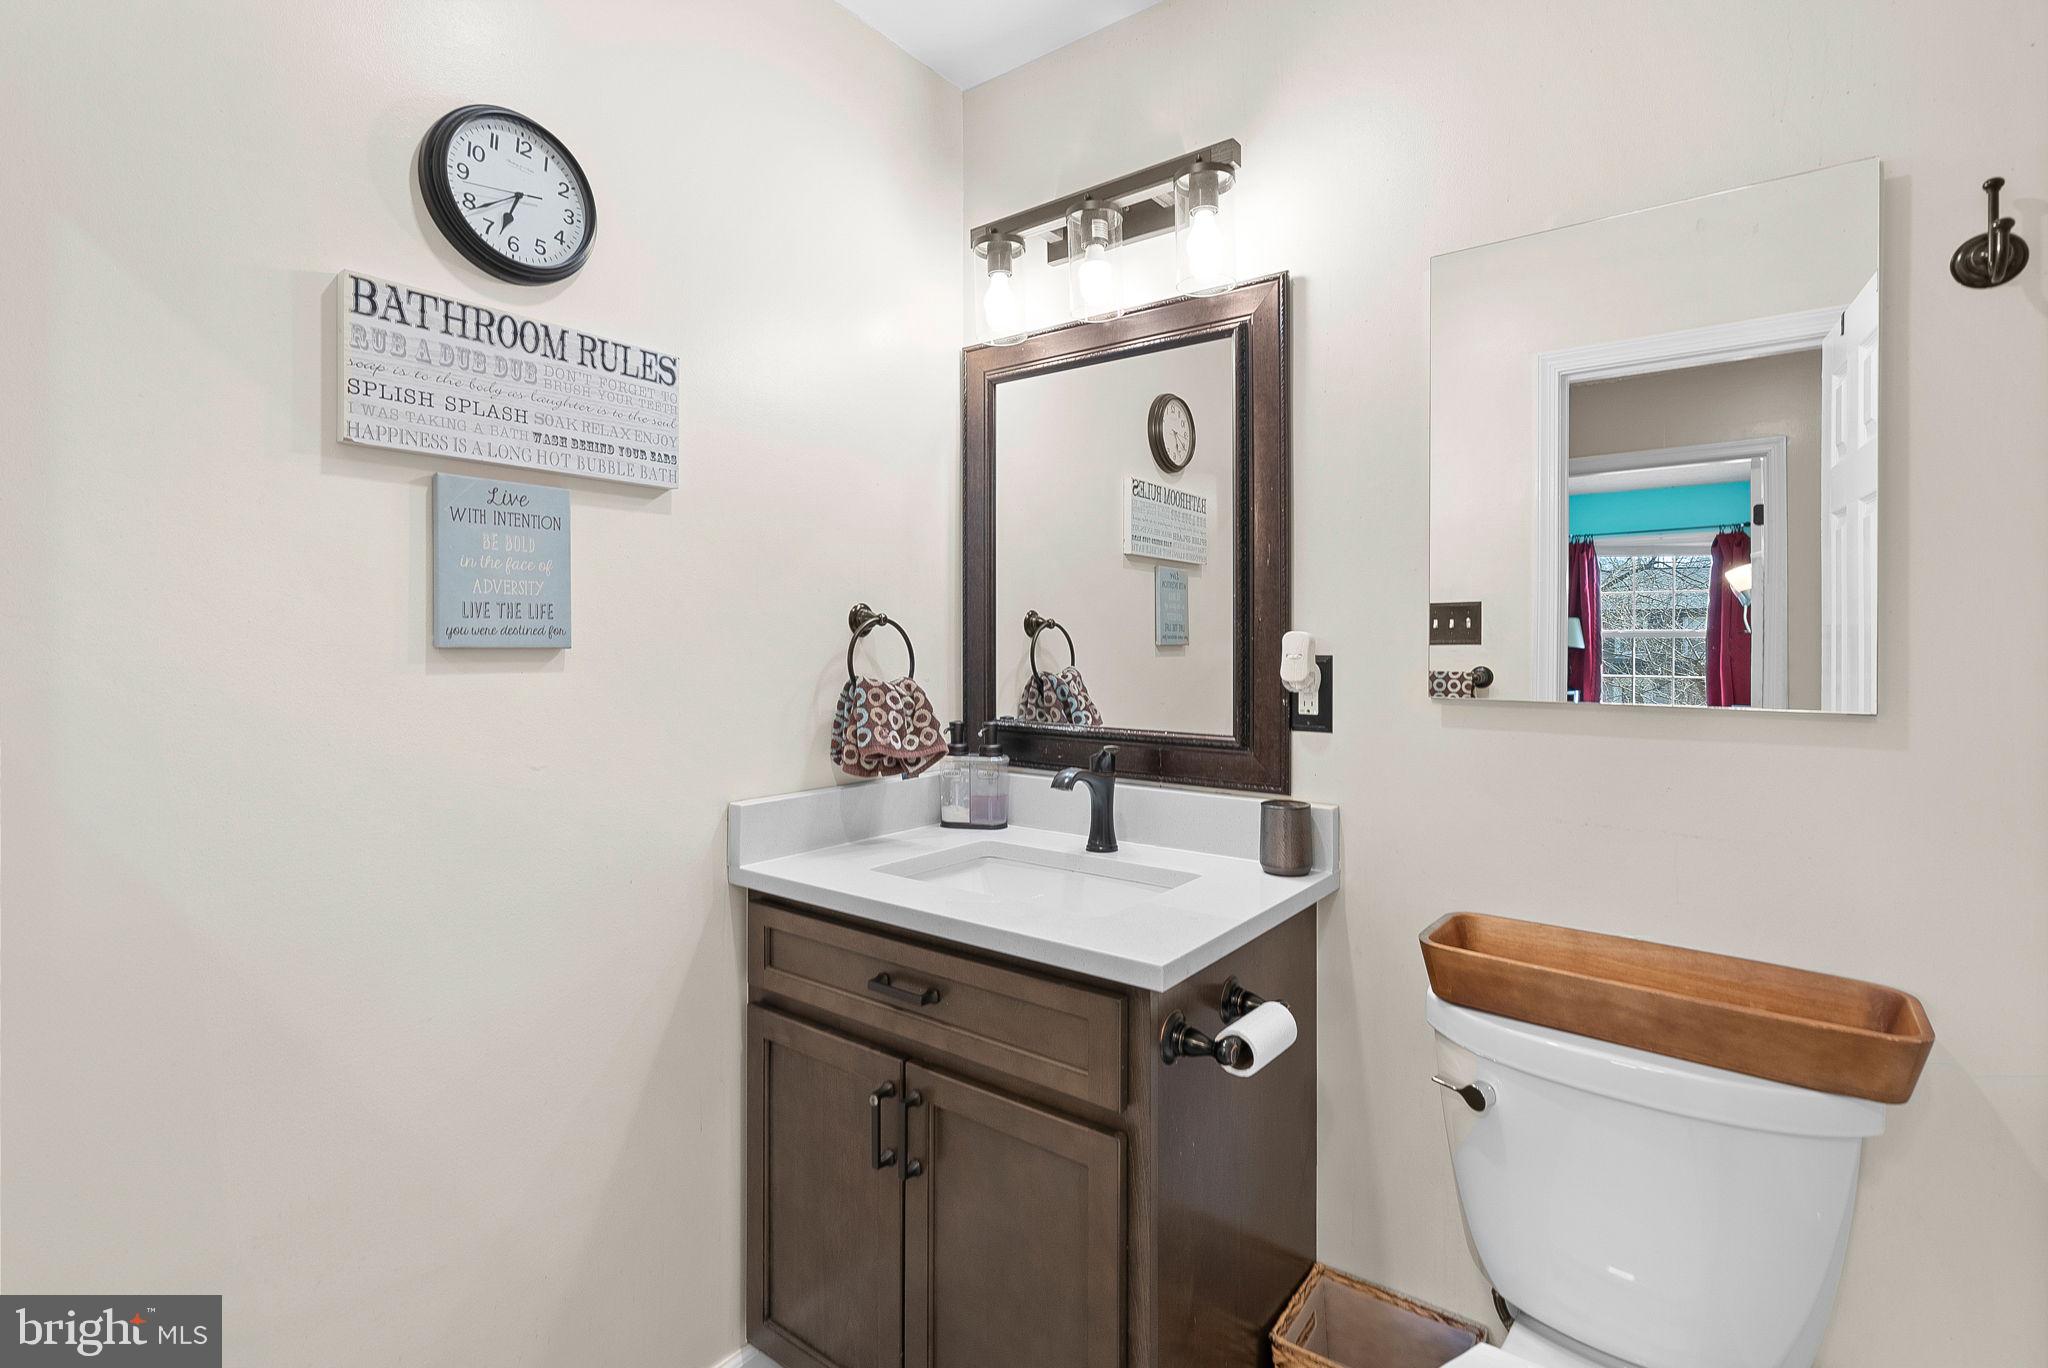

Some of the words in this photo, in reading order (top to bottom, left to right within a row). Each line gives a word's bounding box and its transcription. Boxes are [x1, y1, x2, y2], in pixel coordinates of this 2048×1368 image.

[489, 132, 499, 150] 11
[515, 138, 533, 159] 12
[467, 141, 485, 162] 10
[456, 162, 470, 180] 9
[544, 156, 548, 172] 1
[557, 182, 570, 199] 2
[462, 193, 476, 209] 8
[483, 218, 495, 234] 7
[563, 209, 574, 225] 3
[507, 236, 520, 252] 6
[534, 239, 546, 255] 5
[554, 230, 565, 246] 4
[349, 275, 569, 362] BATHROOM
[577, 332, 680, 386] RULES
[349, 323, 406, 358] RUB
[416, 339, 432, 365] A
[439, 342, 486, 375] DUB
[493, 356, 538, 385] DUB
[347, 358, 386, 376] soap
[392, 365, 407, 376] is
[415, 370, 430, 381] to
[436, 372, 464, 387] the
[469, 379, 502, 399] body
[507, 390, 523, 400] as
[530, 389, 594, 413] laughter
[596, 405, 608, 415] is
[613, 408, 624, 419] to
[628, 410, 648, 424] the
[651, 416, 678, 428] soul
[544, 365, 592, 385] DON'T
[599, 377, 656, 399] FORGET
[661, 390, 678, 404] TO
[544, 380, 591, 397] BRUSH
[598, 389, 633, 406] YOUR
[638, 398, 678, 415] TEETH
[347, 378, 435, 408] SPLISH
[444, 395, 529, 424] SPLASH
[534, 412, 581, 431] SOAK
[581, 421, 631, 441] RELAX
[634, 431, 678, 448] ENJOY
[348, 401, 354, 413] I
[361, 403, 399, 420] WAS
[406, 411, 468, 431] TAKING
[473, 423, 484, 434] A
[490, 425, 529, 441] BATH
[532, 432, 568, 448] WASH
[571, 438, 615, 455] BEHIND
[618, 446, 647, 461] YOUR
[650, 452, 678, 465] EARS
[346, 420, 449, 450] HAPPINESS
[453, 438, 467, 453] IS
[472, 440, 483, 456] A
[487, 442, 533, 463] LONG
[537, 451, 572, 469] HOT
[576, 455, 635, 478] BUBBLE
[640, 464, 678, 484] BATH
[486, 487, 530, 507] Live
[450, 506, 486, 524] WITH
[493, 510, 561, 531] INTENTION
[482, 533, 498, 550] BE
[505, 535, 535, 552] BOLD
[459, 556, 477, 567] in
[480, 555, 503, 569] the
[504, 557, 536, 573] face
[538, 559, 553, 576] of
[473, 579, 544, 596] ADVERSITY
[462, 601, 490, 618] LIVE
[496, 602, 522, 619] THE
[528, 603, 554, 619] LIFE
[445, 626, 469, 639] you
[471, 625, 498, 636] were
[500, 625, 546, 636] destined
[548, 626, 566, 639] for
